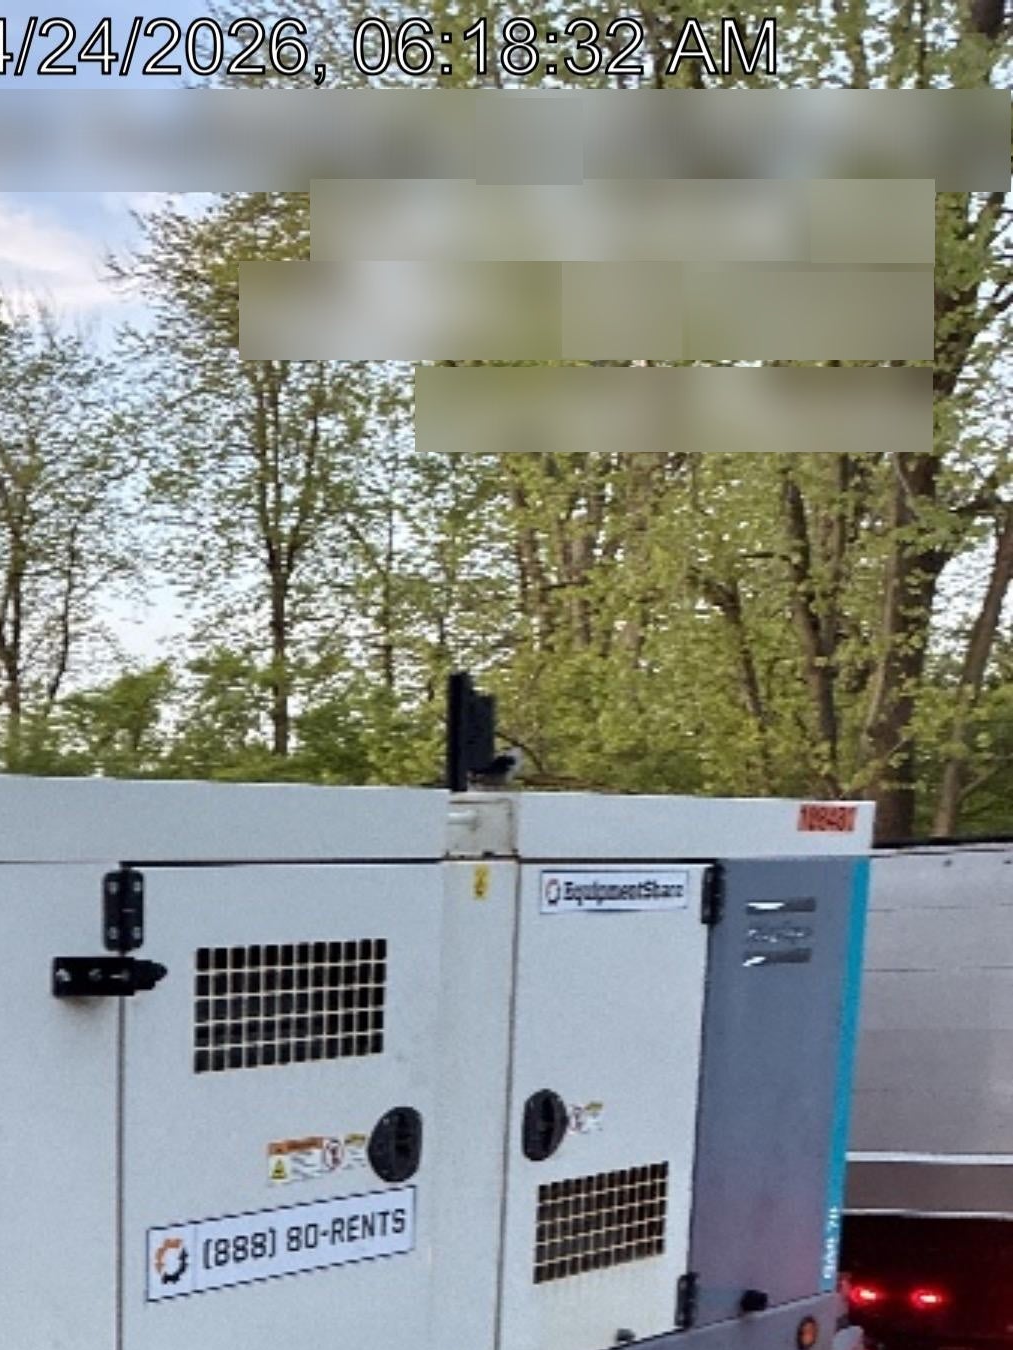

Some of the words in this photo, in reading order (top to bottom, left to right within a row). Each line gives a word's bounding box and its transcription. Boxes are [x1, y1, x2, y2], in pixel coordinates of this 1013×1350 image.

[563, 880, 684, 906] EquipmentShare
[202, 1227, 276, 1270] (888)
[286, 1209, 406, 1251] 80-RENTS
